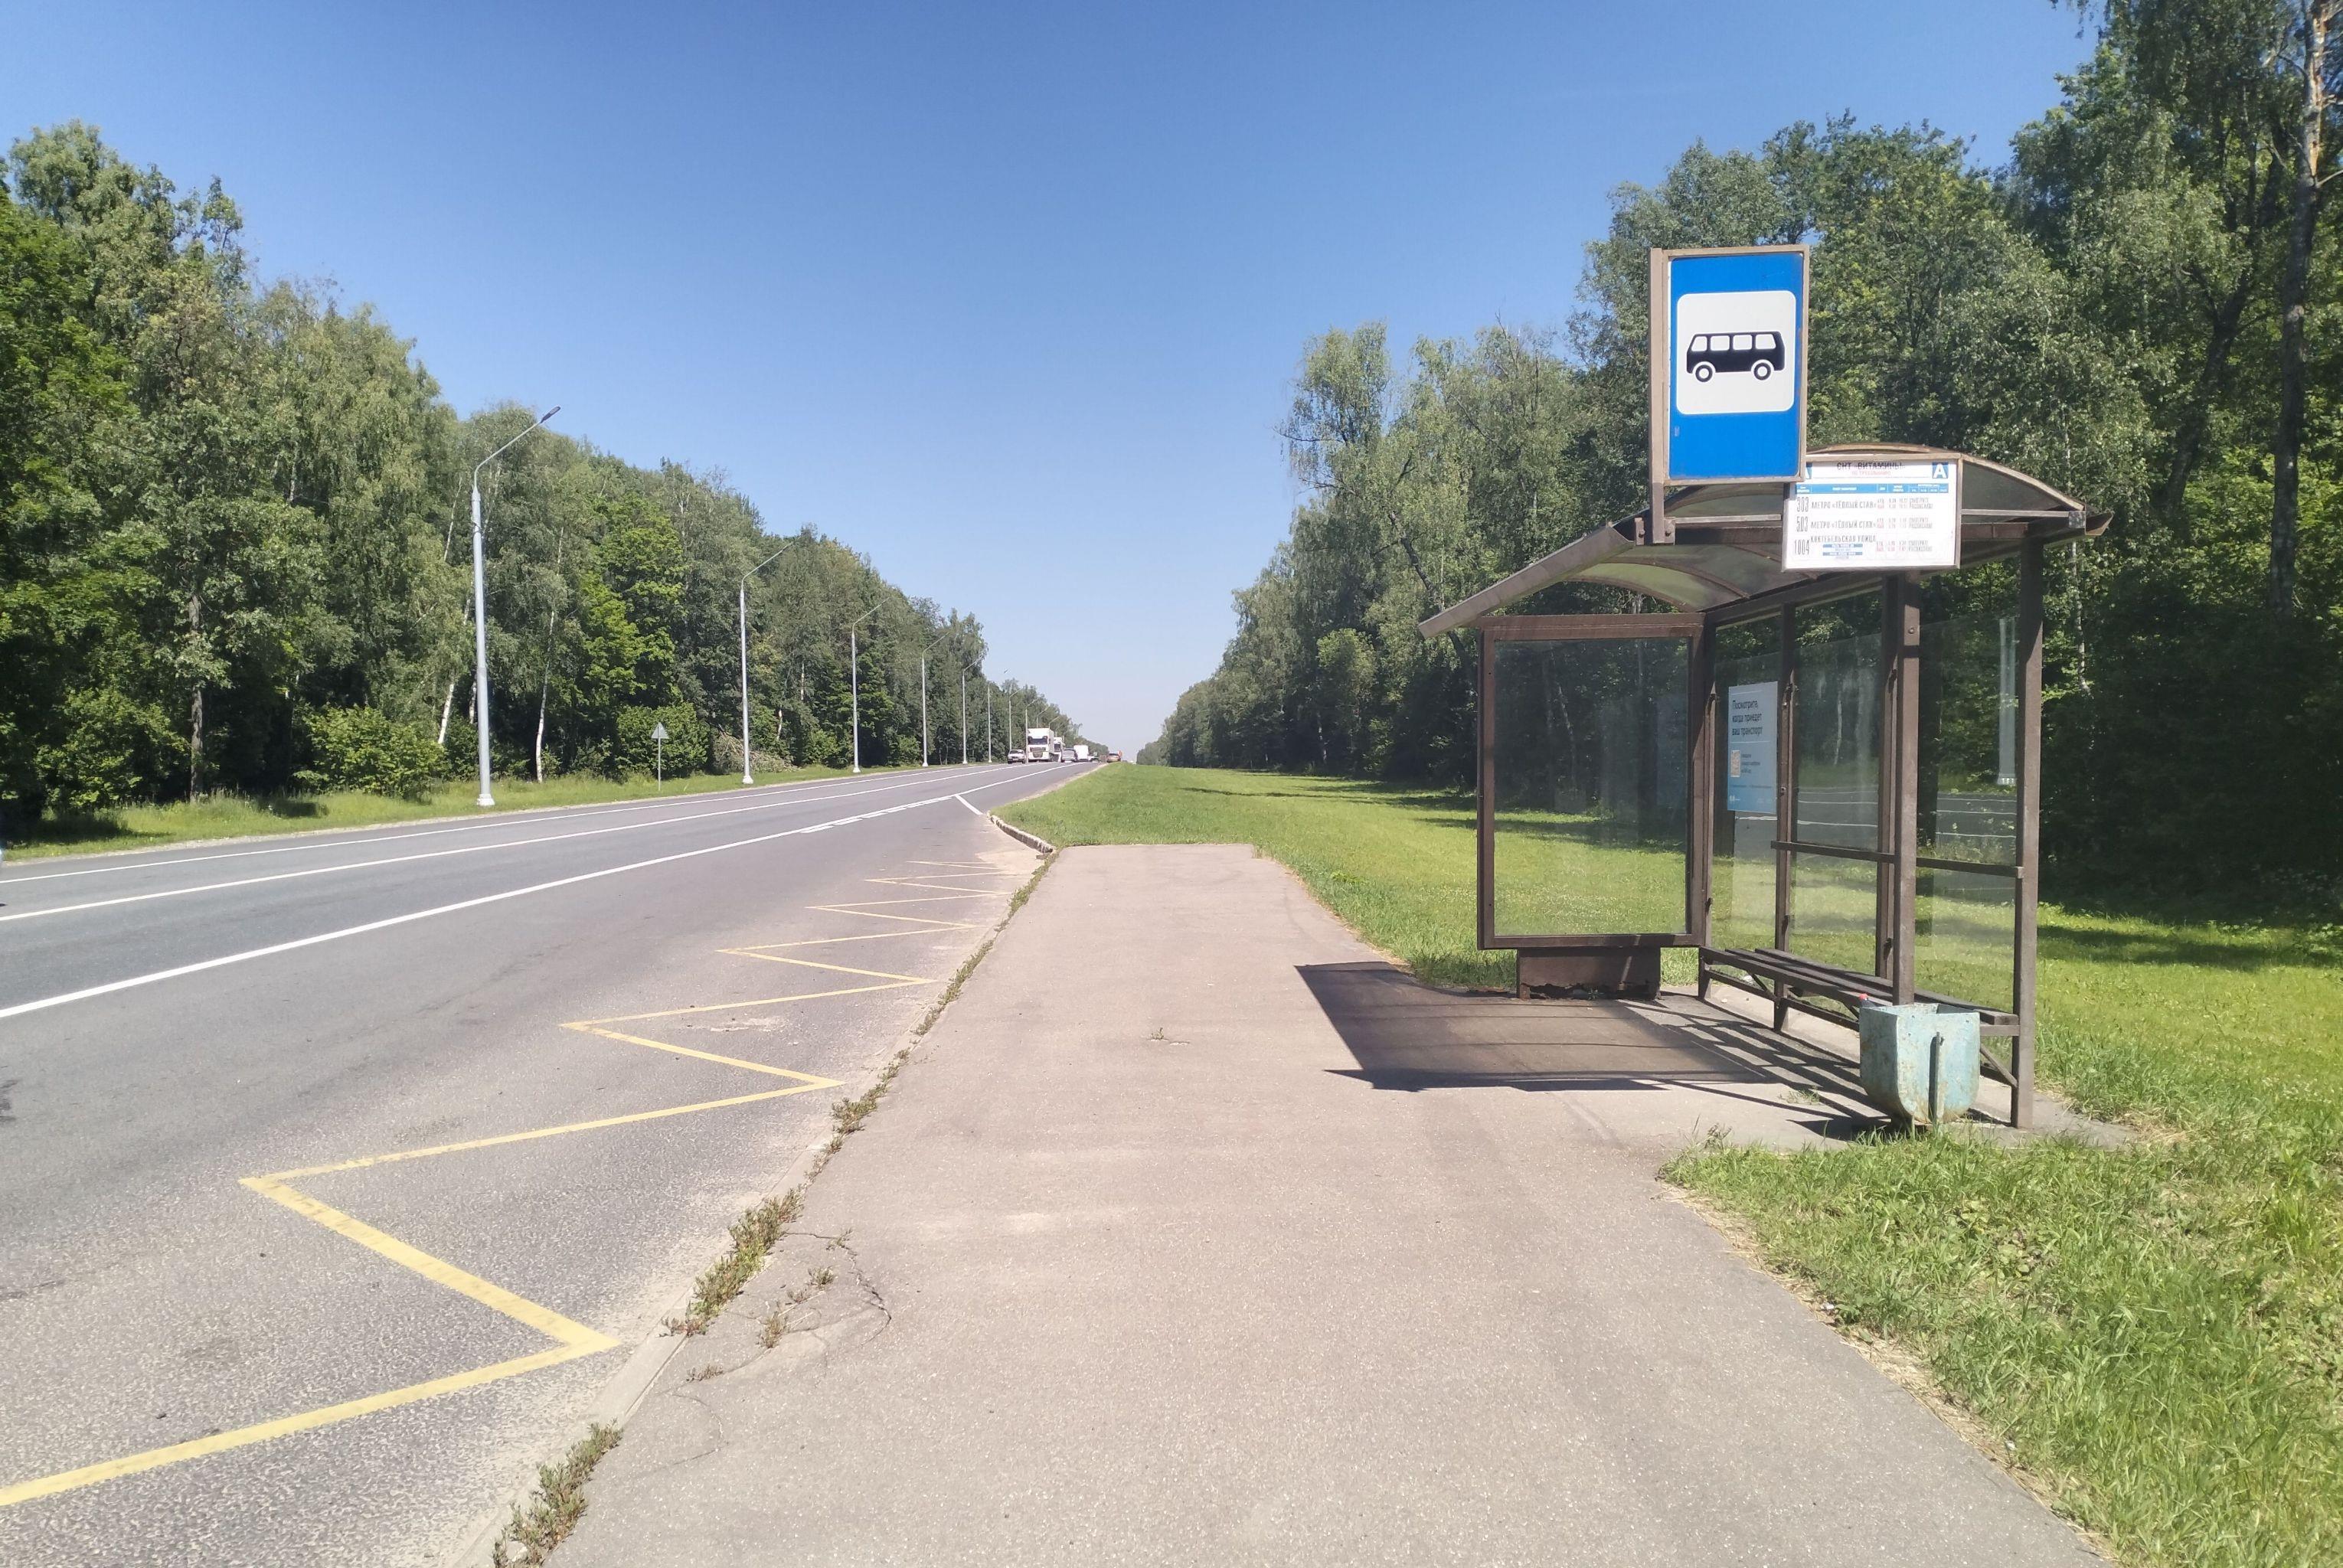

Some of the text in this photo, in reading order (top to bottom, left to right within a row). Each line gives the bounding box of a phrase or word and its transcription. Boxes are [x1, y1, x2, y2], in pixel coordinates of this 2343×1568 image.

[1836, 462, 1852, 470] СНТ
[1796, 497, 1809, 512] 303
[1812, 501, 1831, 509] МЕТРО
[1796, 516, 1809, 532] 503
[1810, 521, 1830, 529] МЕТРО
[1794, 539, 1809, 556] 1004
